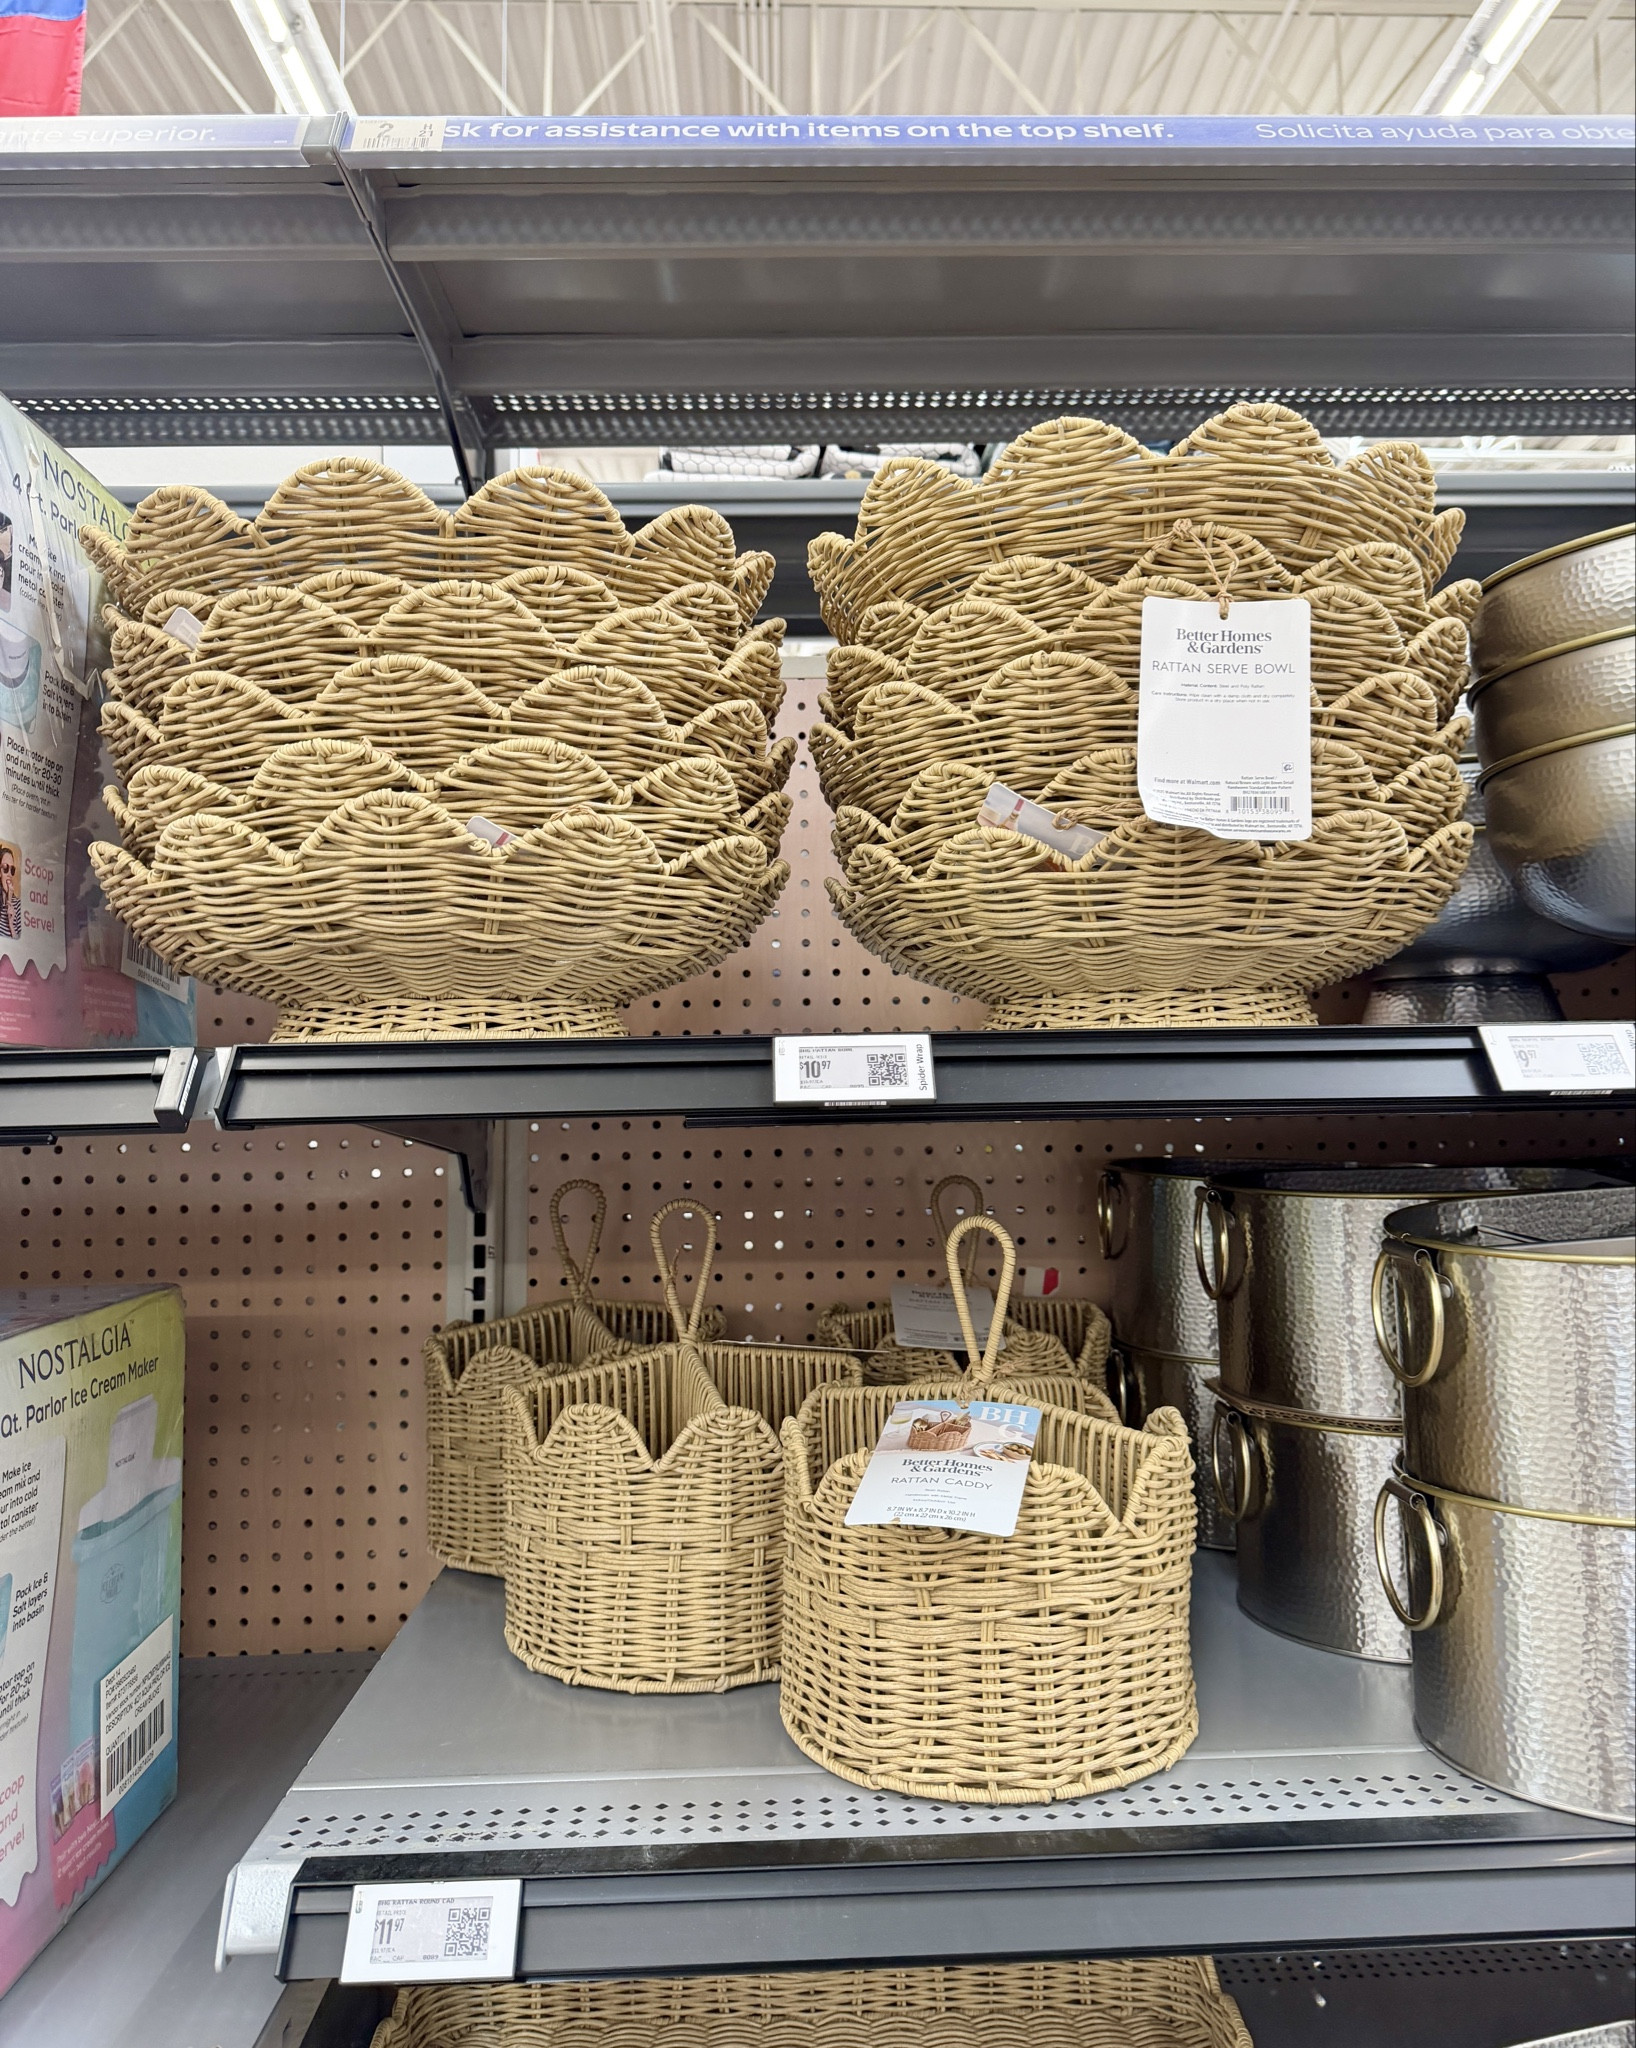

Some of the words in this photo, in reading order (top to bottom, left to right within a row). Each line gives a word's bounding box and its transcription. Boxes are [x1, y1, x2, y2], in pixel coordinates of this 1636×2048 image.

[72, 125, 216, 145] superior.
[377, 122, 394, 141] 2
[444, 122, 481, 138] sk
[490, 122, 539, 138] for
[545, 121, 720, 138] assistance
[728, 121, 800, 138] with
[808, 121, 900, 138] items
[907, 123, 950, 138] on
[956, 122, 1013, 138] the
[1018, 122, 1077, 141] top
[1083, 122, 1174, 139] shelf.
[1254, 122, 1374, 139] Solicita
[1380, 123, 1478, 141] ayuda
[1483, 127, 1557, 142] para
[12, 472, 23, 495] 4
[50, 500, 80, 540] Parl
[1176, 628, 1219, 642] Better
[1220, 630, 1272, 642] Homes
[1187, 641, 1199, 653] &
[1200, 641, 1262, 654] Gardens
[1152, 660, 1201, 673] RATTAN
[1207, 663, 1248, 674] SERVE
[1255, 663, 1296, 674] BOWL
[7, 736, 25, 754] Place
[45, 756, 56, 771] top
[56, 763, 64, 774] on
[6, 753, 19, 766] and
[20, 759, 31, 772] run
[41, 768, 62, 786] 20-30
[5, 767, 31, 785] minutes
[45, 782, 60, 798] thick
[24, 857, 54, 885] Scoop
[29, 889, 49, 906] and
[23, 912, 55, 934] Serve!
[916, 1043, 925, 1065] Wrap
[918, 1066, 928, 1091] Spider
[18, 1321, 132, 1389] NOSTALGIA
[1, 1413, 22, 1438] Qt.
[26, 1396, 67, 1428] Parlor
[70, 1388, 88, 1408] Ice
[90, 1371, 126, 1399] Cream
[128, 1357, 159, 1383] Maker
[979, 1406, 1030, 1426] BH
[2, 1467, 21, 1483] Make
[22, 1461, 32, 1474] ice
[902, 1458, 943, 1468] Better
[944, 1459, 993, 1472] Homes
[910, 1465, 921, 1473] &
[923, 1465, 981, 1477] Gardens
[15, 1475, 27, 1492] mix
[28, 1469, 41, 1485] and
[891, 1476, 940, 1484] RATTAN
[944, 1477, 993, 1490] CADDY
[10, 1495, 23, 1510] into
[24, 1485, 39, 1501] cold
[11, 1502, 39, 1524] canister
[15, 1585, 32, 1601] Pack
[32, 1577, 42, 1592] Ice
[12, 1601, 27, 1618] Salt
[26, 1587, 48, 1610] layers
[12, 1616, 26, 1632] into
[26, 1603, 45, 1624] basin
[14, 1668, 26, 1683] top
[26, 1661, 35, 1673] on
[10, 1672, 33, 1698] 20-30
[15, 1687, 30, 1707] thick
